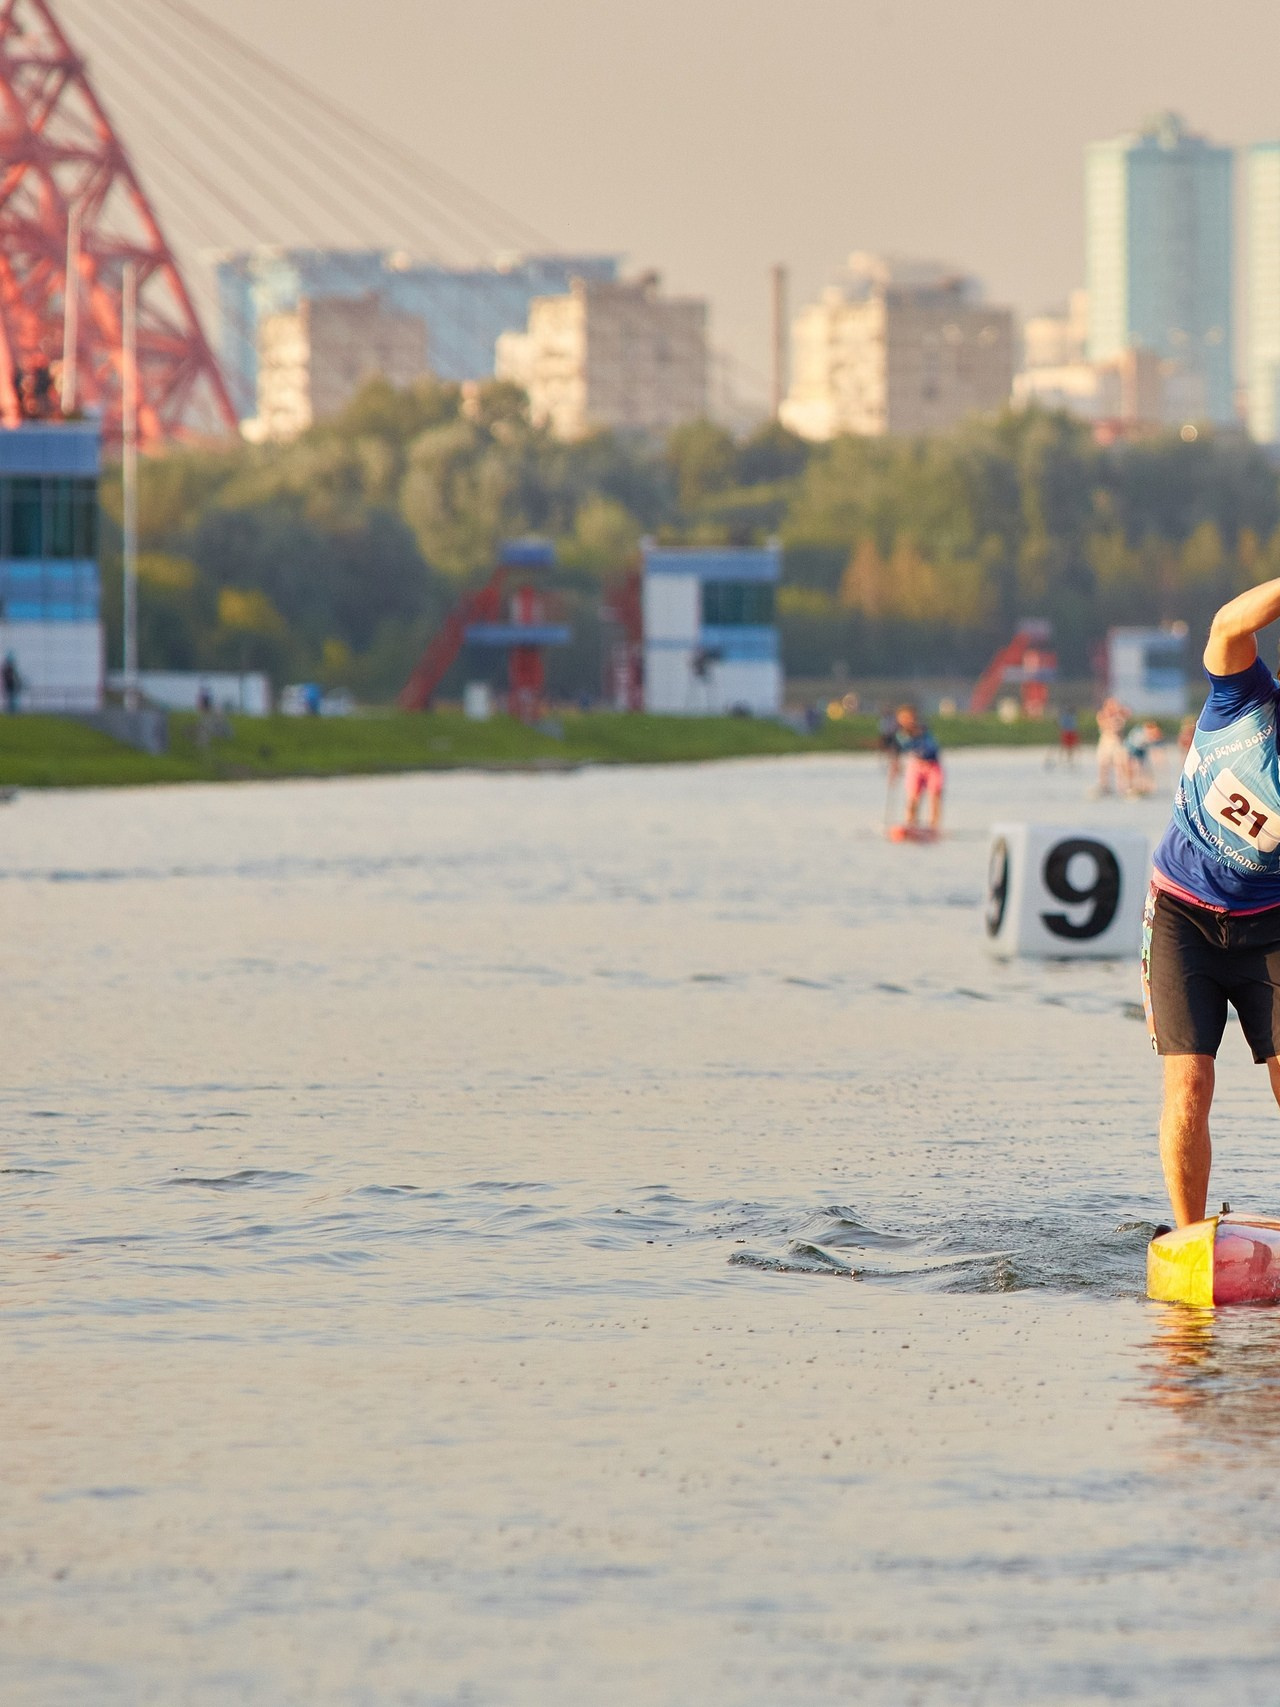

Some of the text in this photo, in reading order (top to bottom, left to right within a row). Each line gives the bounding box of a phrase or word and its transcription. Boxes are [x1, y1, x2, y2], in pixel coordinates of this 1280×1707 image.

[1220, 793, 1269, 838] 21
[1224, 845, 1267, 872] СЛАЛОМ
[1042, 837, 1120, 939] 9
